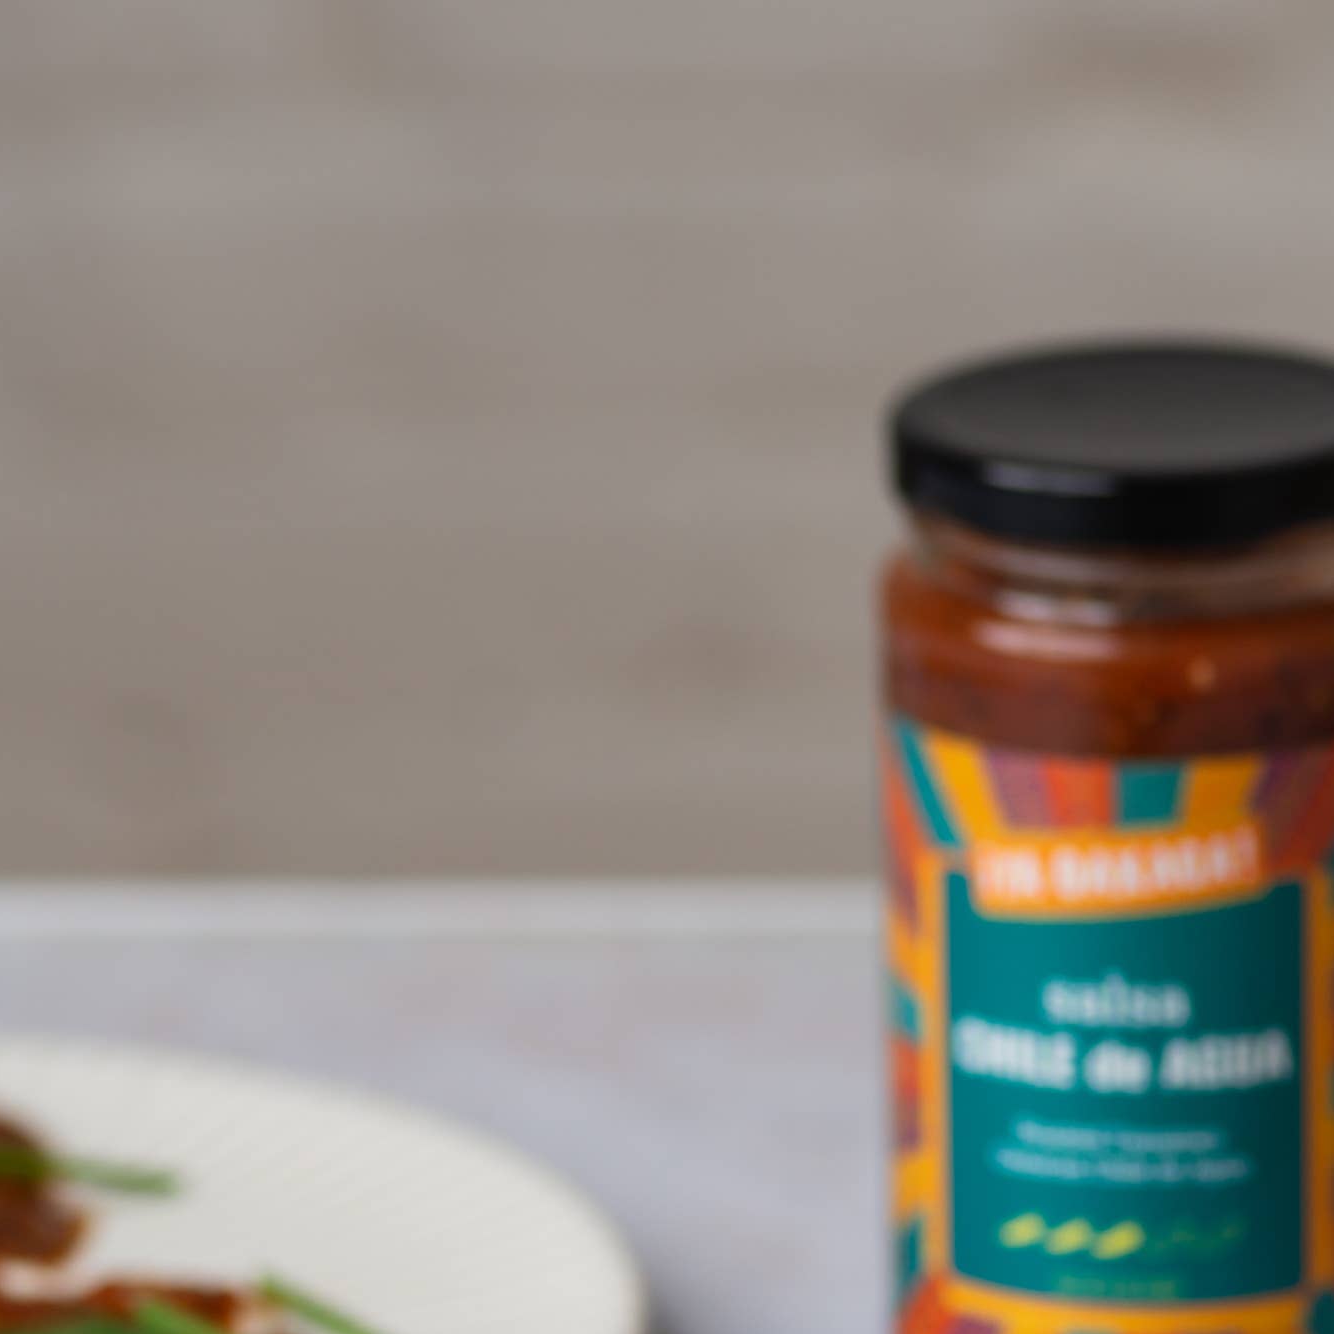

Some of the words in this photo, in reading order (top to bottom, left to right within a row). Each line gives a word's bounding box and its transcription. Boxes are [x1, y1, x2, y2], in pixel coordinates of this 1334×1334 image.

[956, 1018, 1076, 1088] CHILE
[1084, 1041, 1152, 1093] de
[1160, 1029, 1291, 1087] AGUA
